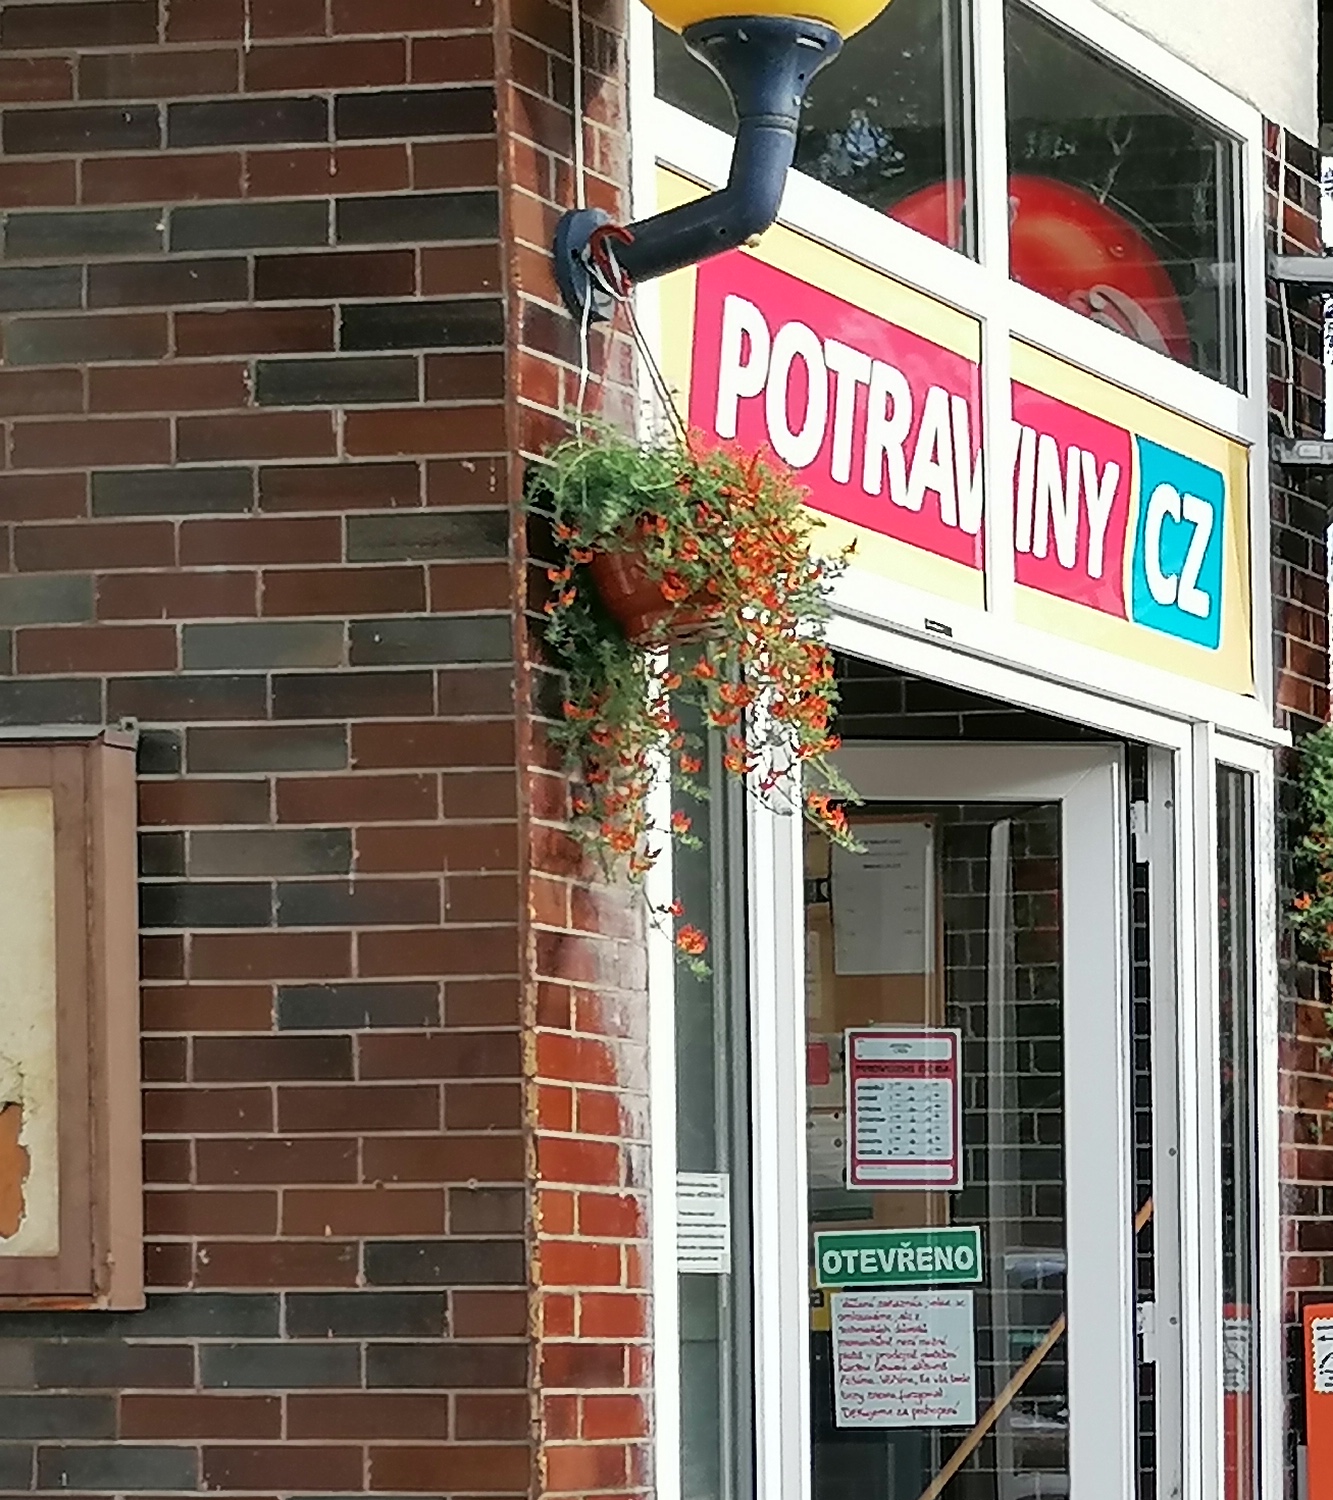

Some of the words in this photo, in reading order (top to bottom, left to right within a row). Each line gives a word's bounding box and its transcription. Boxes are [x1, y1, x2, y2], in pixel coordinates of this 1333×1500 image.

[714, 294, 1121, 578] POTRAVINY
[1144, 483, 1214, 618] CZ
[822, 1241, 974, 1275] OTEVŘENO
